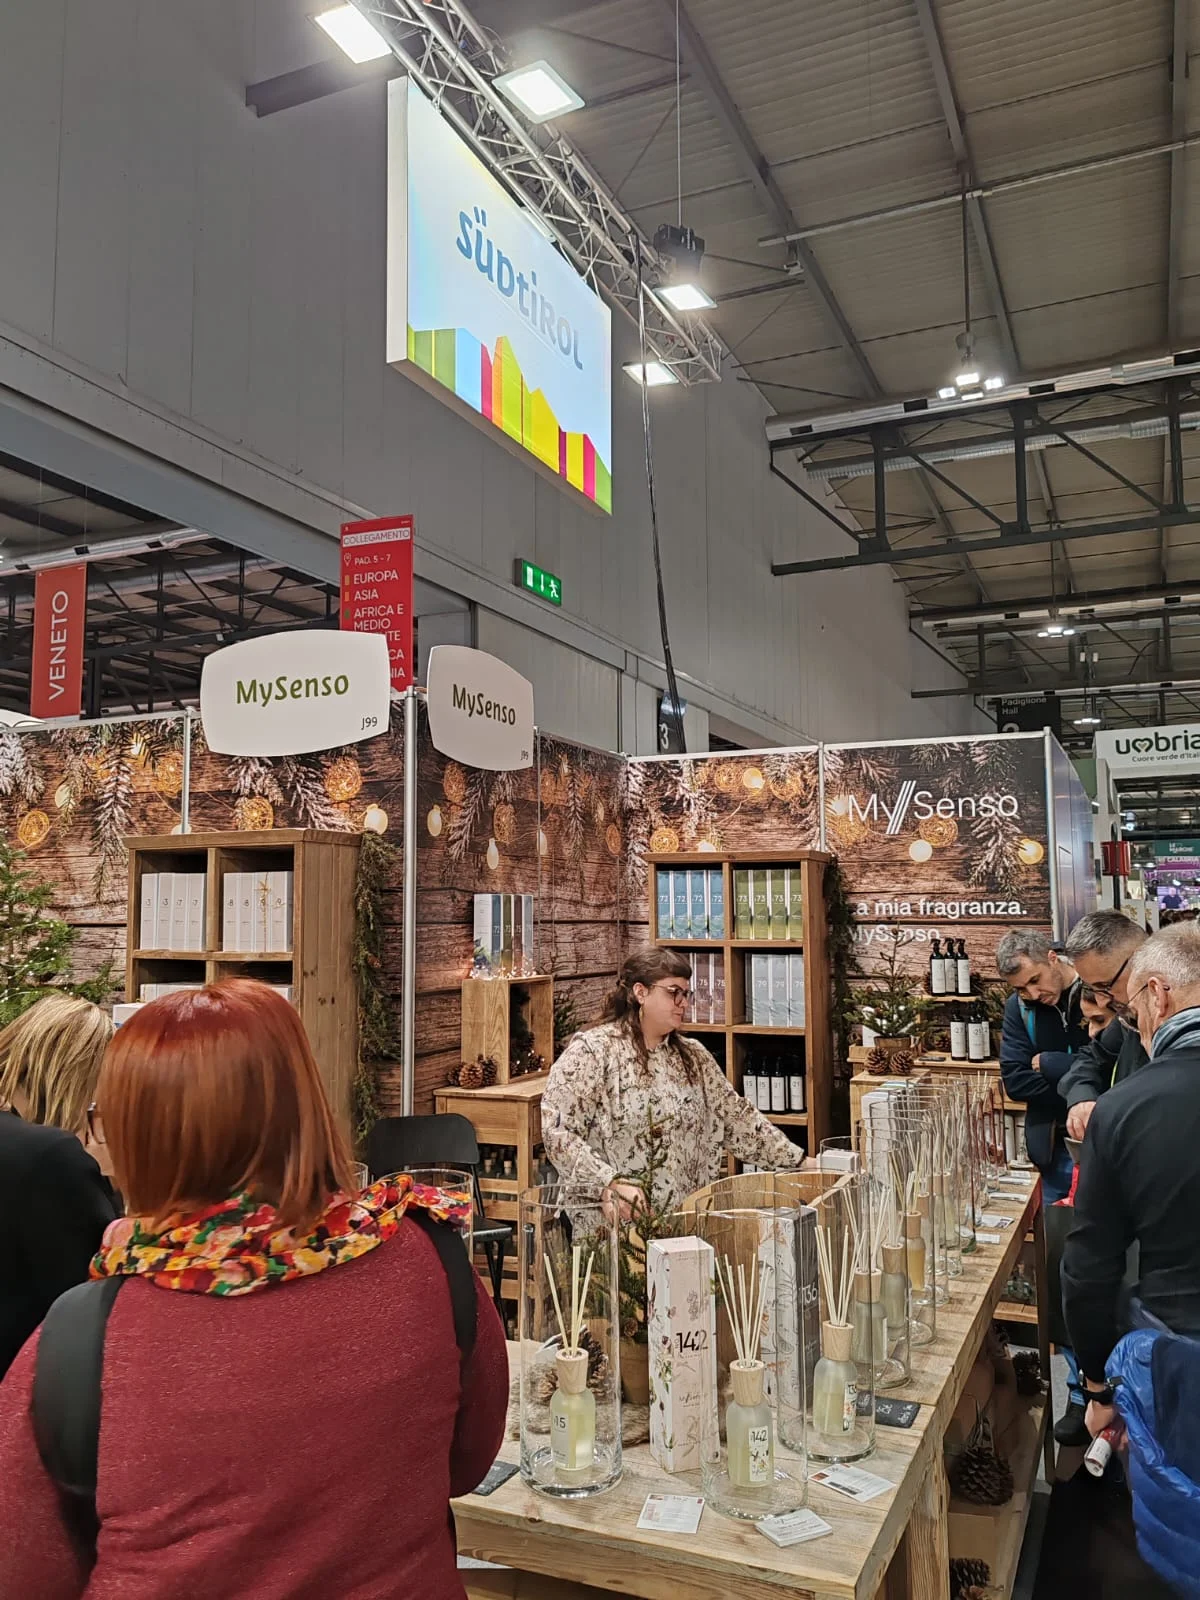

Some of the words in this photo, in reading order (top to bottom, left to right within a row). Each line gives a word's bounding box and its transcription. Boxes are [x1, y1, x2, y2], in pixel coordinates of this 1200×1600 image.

[343, 529, 410, 545] COLLEGAMENTO
[354, 556, 371, 566] PAD.
[373, 554, 379, 564] 5
[386, 553, 392, 562] 7
[354, 569, 399, 585] EUROPA
[354, 588, 379, 602] ASIA
[354, 605, 394, 619] AFRICA
[397, 604, 404, 615] E
[354, 618, 391, 632] MEDIO
[49, 590, 69, 700] VENETO
[236, 674, 350, 707] MySenso
[452, 684, 517, 726] MySenso
[1002, 706, 1019, 716] Hall
[360, 716, 378, 730] J99
[659, 722, 669, 750] 3
[1132, 754, 1155, 762] Cuore
[1156, 753, 1178, 761] verde
[875, 898, 912, 916] mia
[918, 898, 1028, 919] fragranza.
[676, 1330, 708, 1353] 142
[752, 1429, 768, 1442] 142
